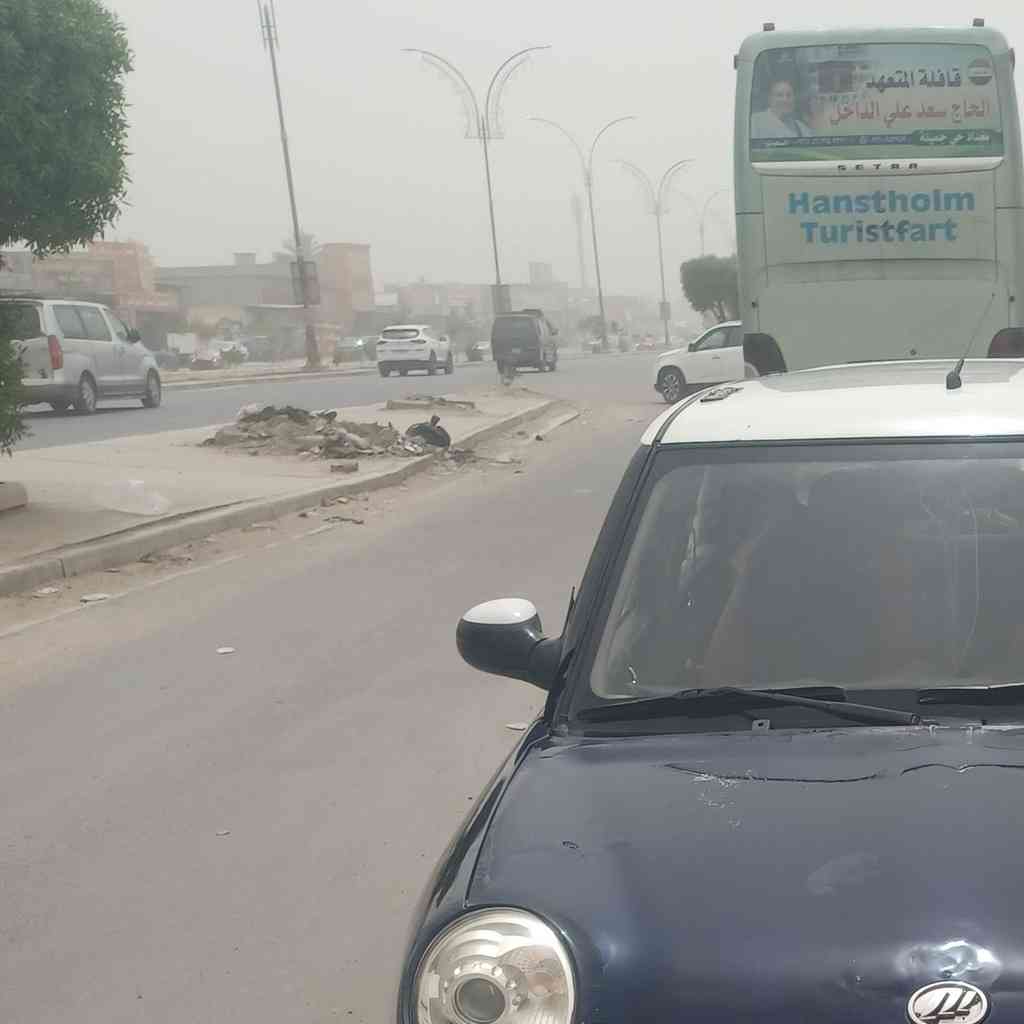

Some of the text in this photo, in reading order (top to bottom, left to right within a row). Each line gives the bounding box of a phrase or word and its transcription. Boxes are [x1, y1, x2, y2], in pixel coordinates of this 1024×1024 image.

[865, 67, 962, 93] قافلة المتعهد
[883, 100, 913, 127] علي
[916, 103, 947, 119] سعد
[951, 99, 990, 124] الحاج
[837, 162, 919, 171] SETRA
[788, 189, 976, 215] Hanstholm
[800, 218, 958, 245] Turistfart
